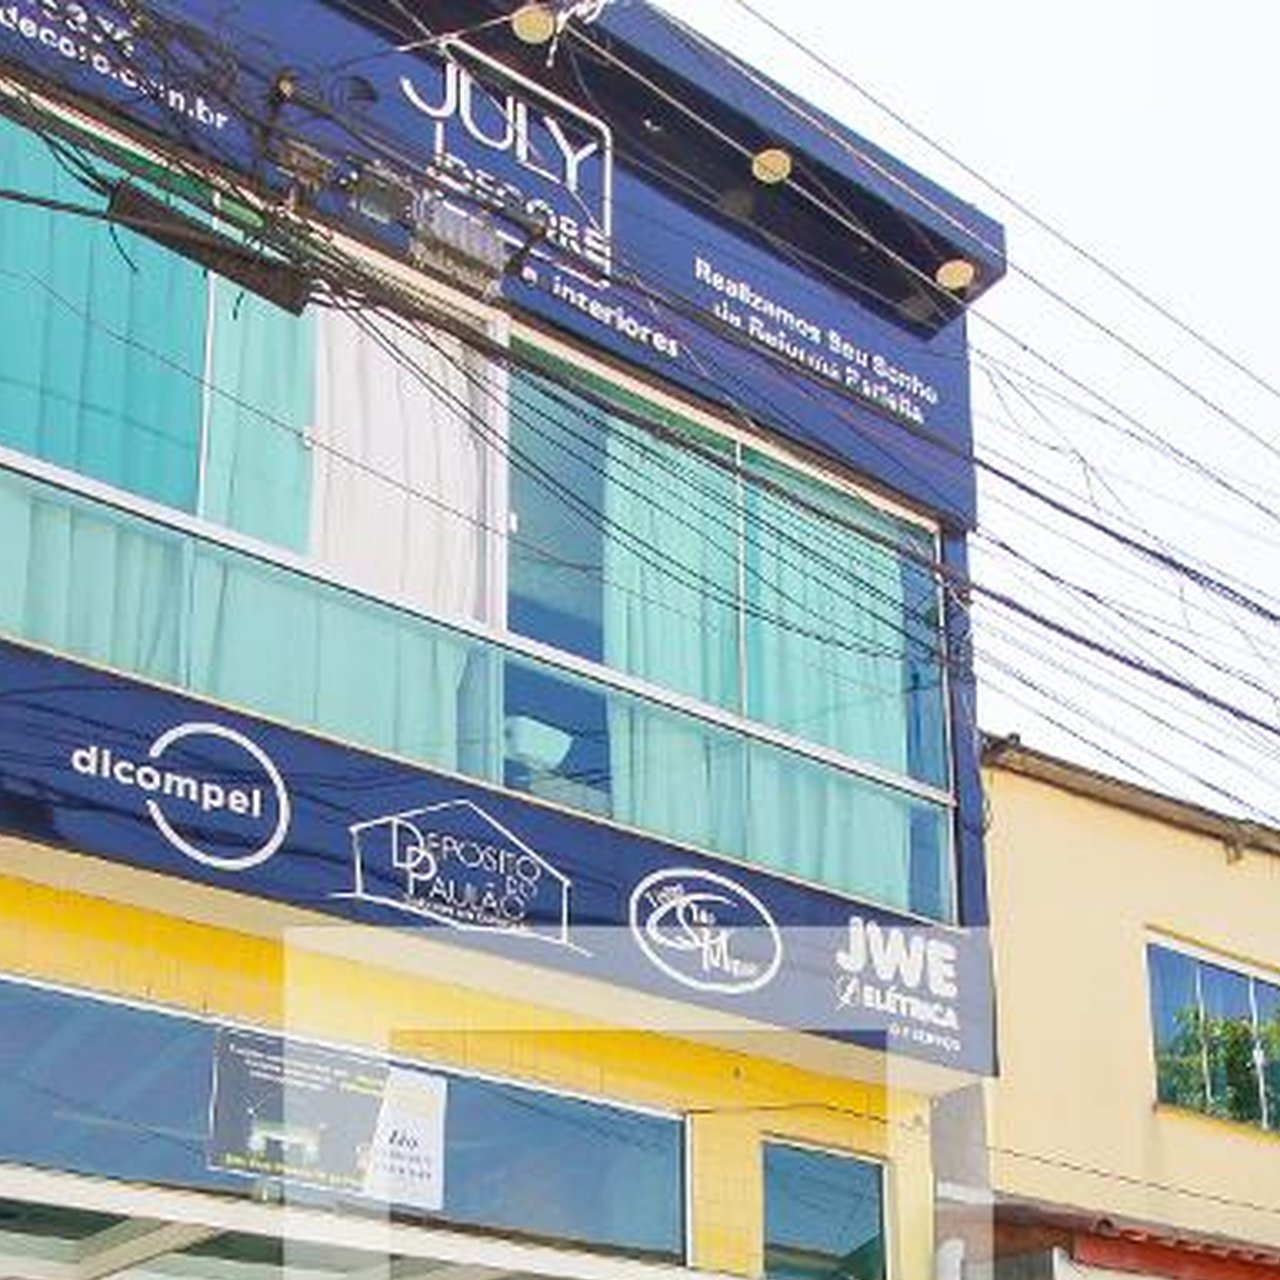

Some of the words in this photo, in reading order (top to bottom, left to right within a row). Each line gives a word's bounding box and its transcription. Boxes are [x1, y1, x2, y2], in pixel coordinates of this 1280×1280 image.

[400, 62, 598, 192] JULY
[553, 275, 680, 358] interiores
[694, 256, 822, 345] Realizamos
[828, 328, 870, 369] Seu
[70, 745, 262, 818] dicompel
[835, 914, 959, 998] JWE
